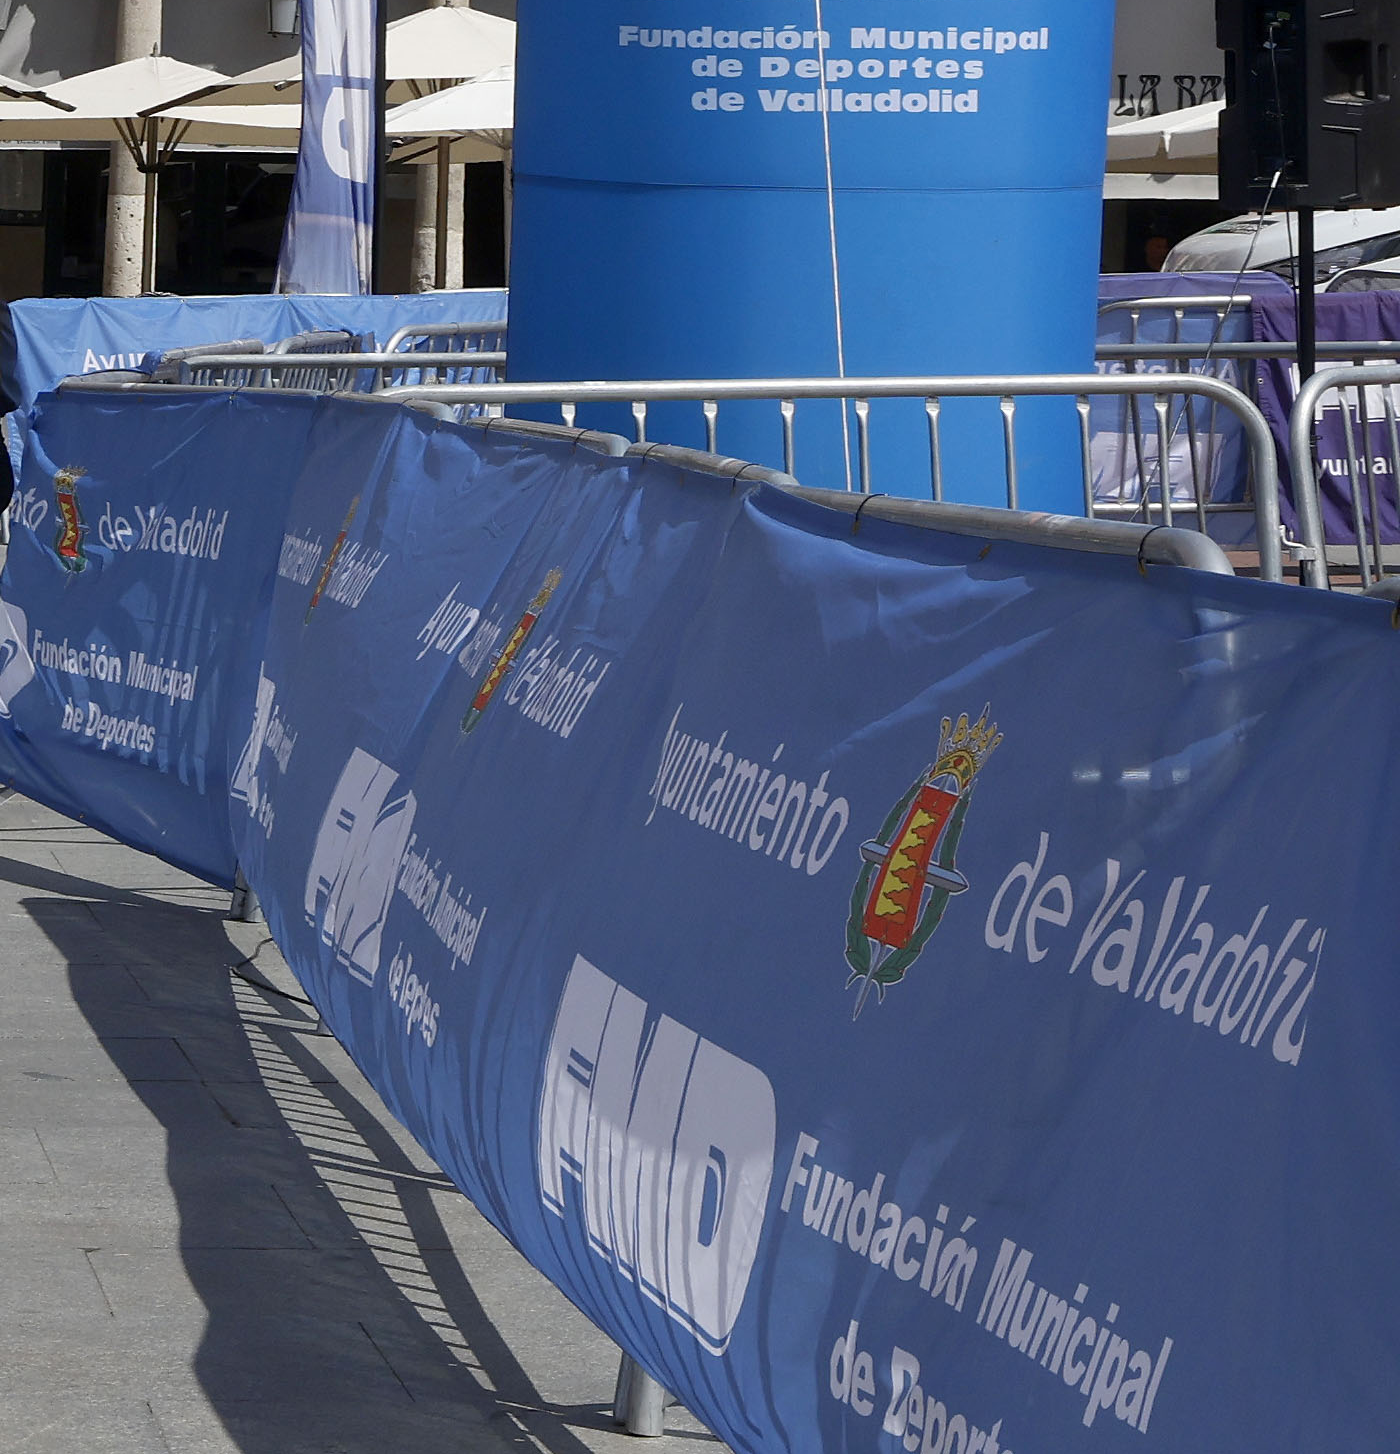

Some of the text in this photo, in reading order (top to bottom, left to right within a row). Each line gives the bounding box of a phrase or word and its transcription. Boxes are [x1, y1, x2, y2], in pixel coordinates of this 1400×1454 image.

[619, 24, 1049, 53] Fundación Municipal
[691, 55, 984, 83] de Deportes
[1114, 74, 1161, 116] LA
[691, 87, 979, 113] de Valladolid
[99, 502, 132, 552] de
[32, 629, 123, 684] Fundación
[126, 650, 199, 706] Municipal
[61, 697, 156, 753] de Deportes
[984, 831, 1074, 963] de
[537, 953, 777, 1357] FMD
[780, 1131, 1174, 1435] Fundación Municipal
[830, 1319, 877, 1417] de
